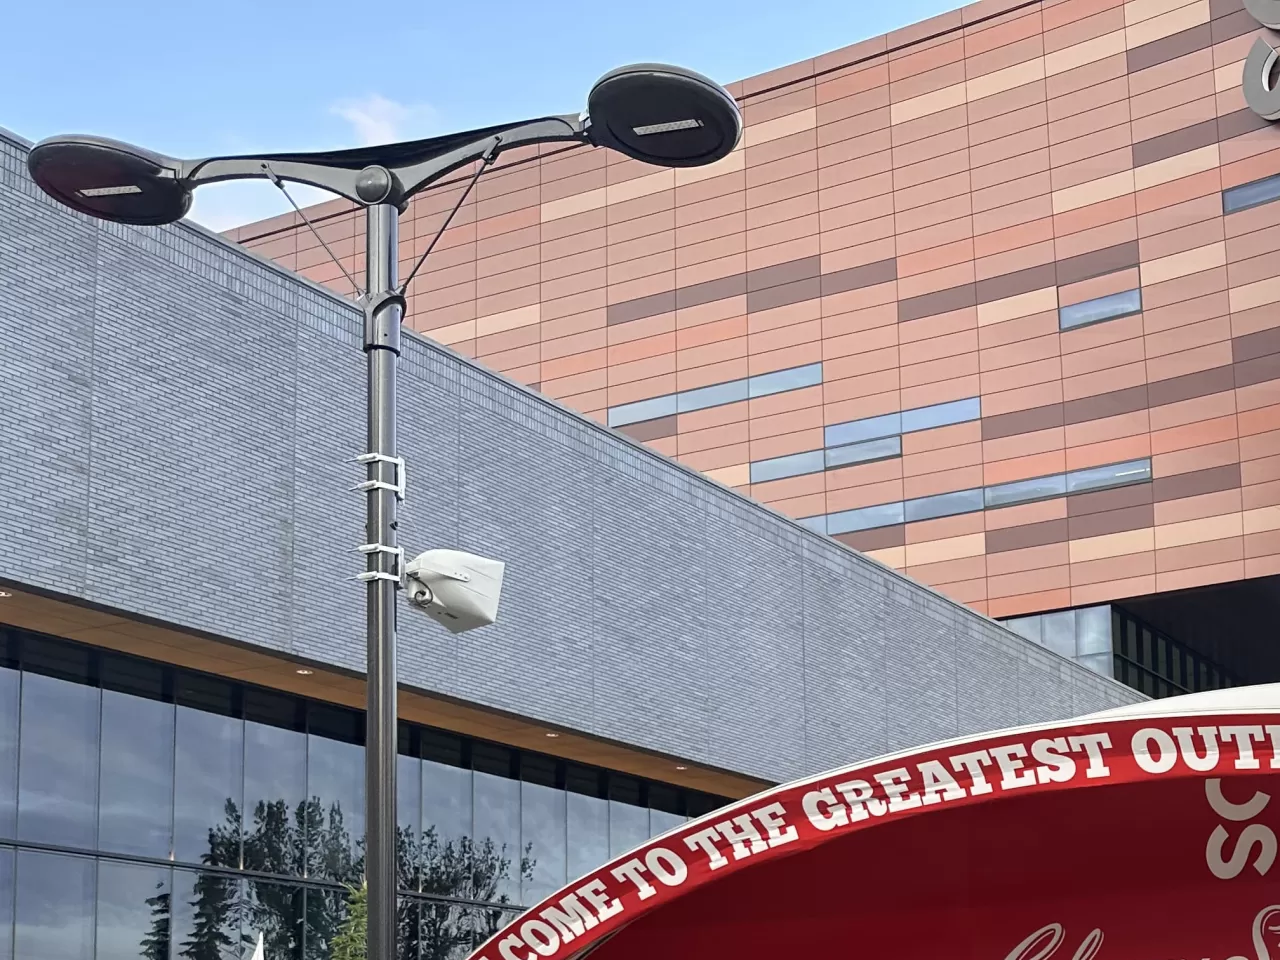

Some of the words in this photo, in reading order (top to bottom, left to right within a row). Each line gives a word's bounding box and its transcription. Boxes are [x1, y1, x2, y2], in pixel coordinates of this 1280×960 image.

[610, 847, 688, 901] TO
[683, 801, 799, 871] THE
[801, 732, 1113, 831] GREATEST
